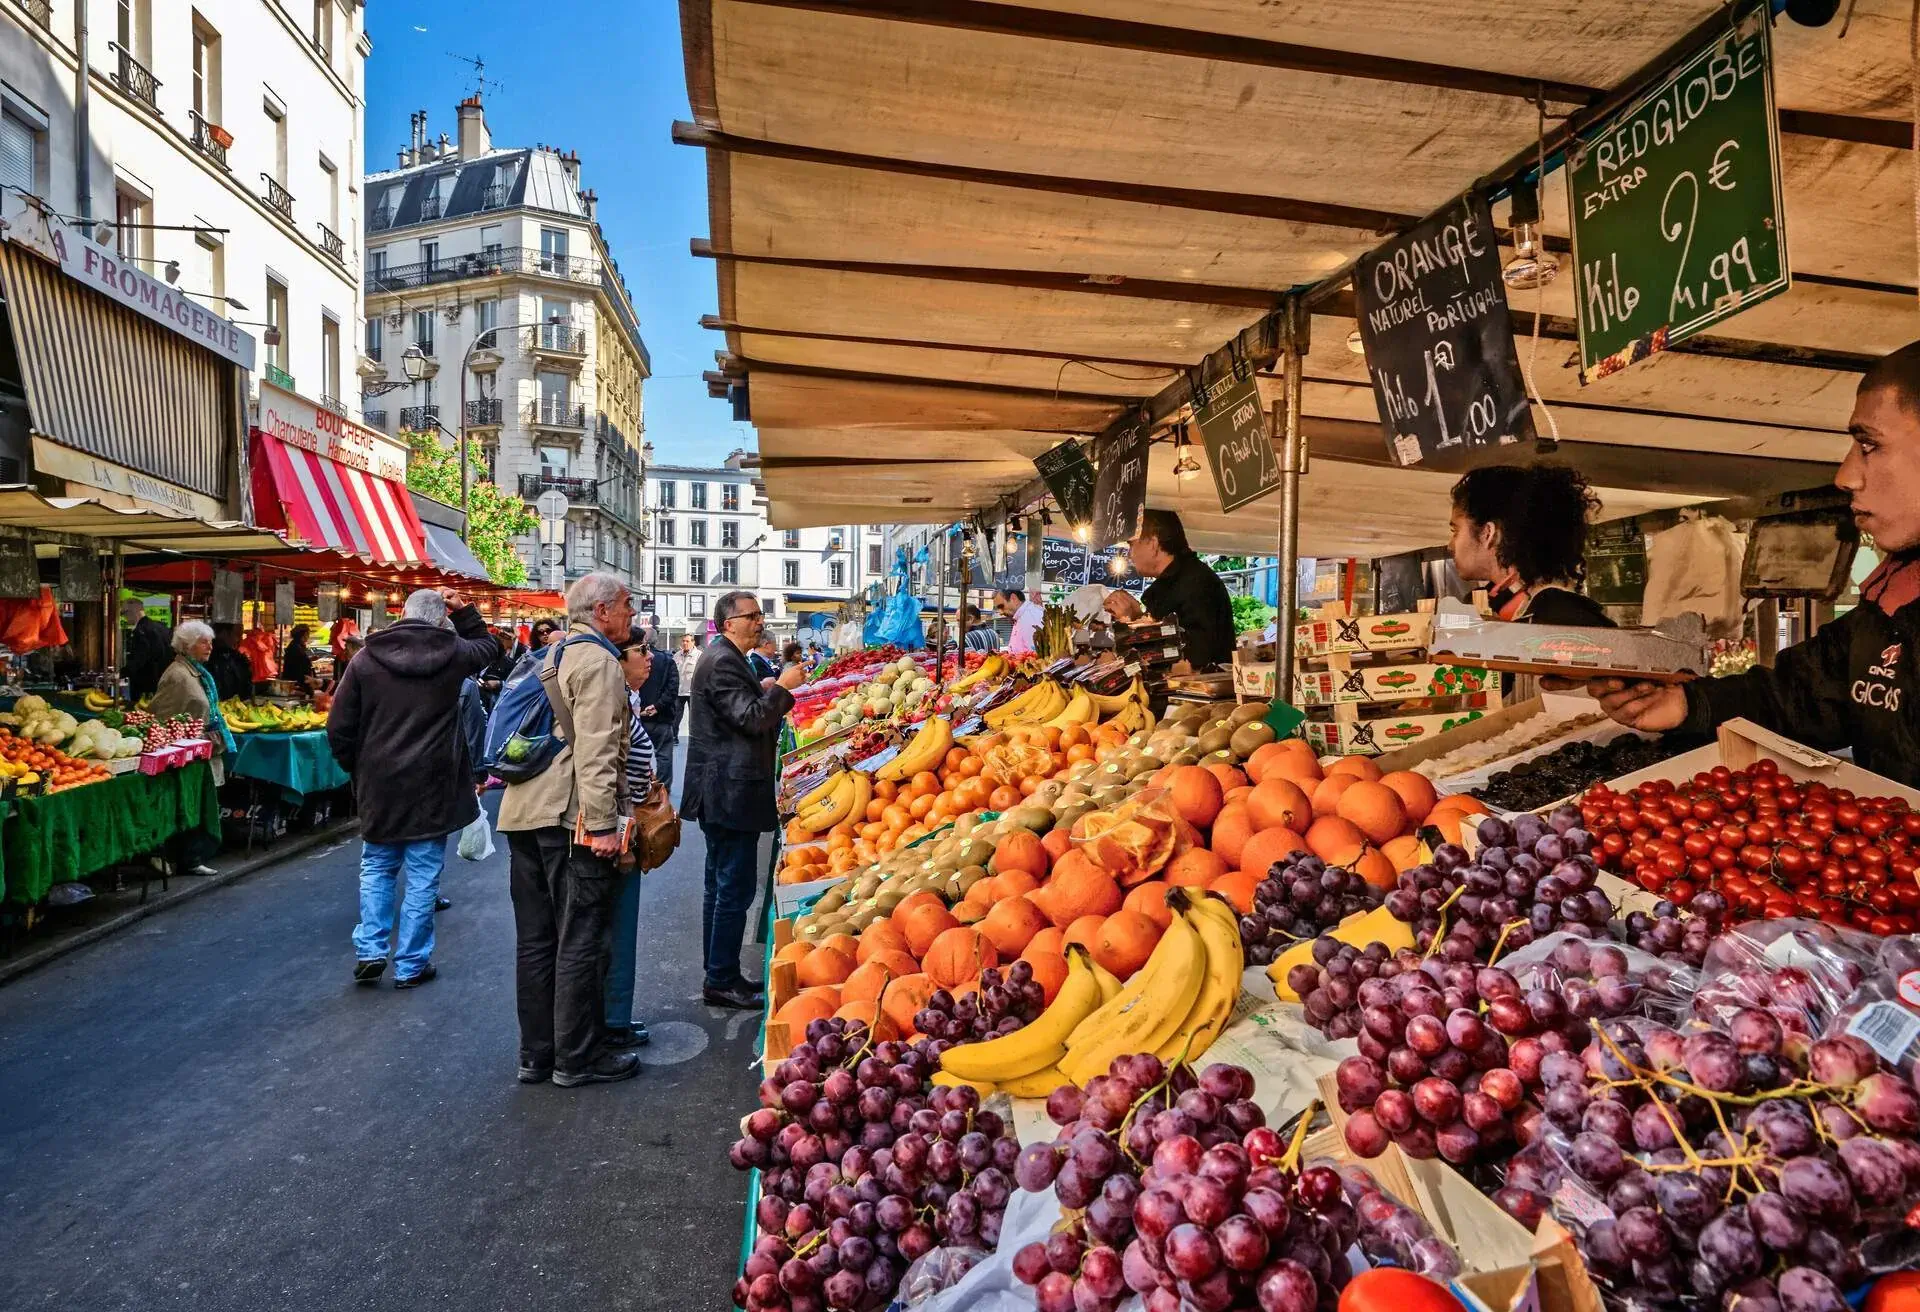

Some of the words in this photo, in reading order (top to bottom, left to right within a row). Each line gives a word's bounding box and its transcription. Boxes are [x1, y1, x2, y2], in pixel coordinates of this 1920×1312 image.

[1584, 166, 1648, 219] EXTRA
[1375, 218, 1486, 302] ORANGE
[84, 245, 239, 354] FROMAGERIE
[1369, 288, 1433, 335] NATUREL
[1426, 281, 1503, 333] PORTUGAL
[1584, 252, 1640, 332] Kilo
[1378, 368, 1419, 423] Kilo
[266, 407, 318, 451] Charcuterie
[327, 436, 369, 470] Hamouche
[315, 408, 375, 451] BOUCHERIE
[91, 460, 113, 485] LA
[1219, 443, 1237, 496] 6
